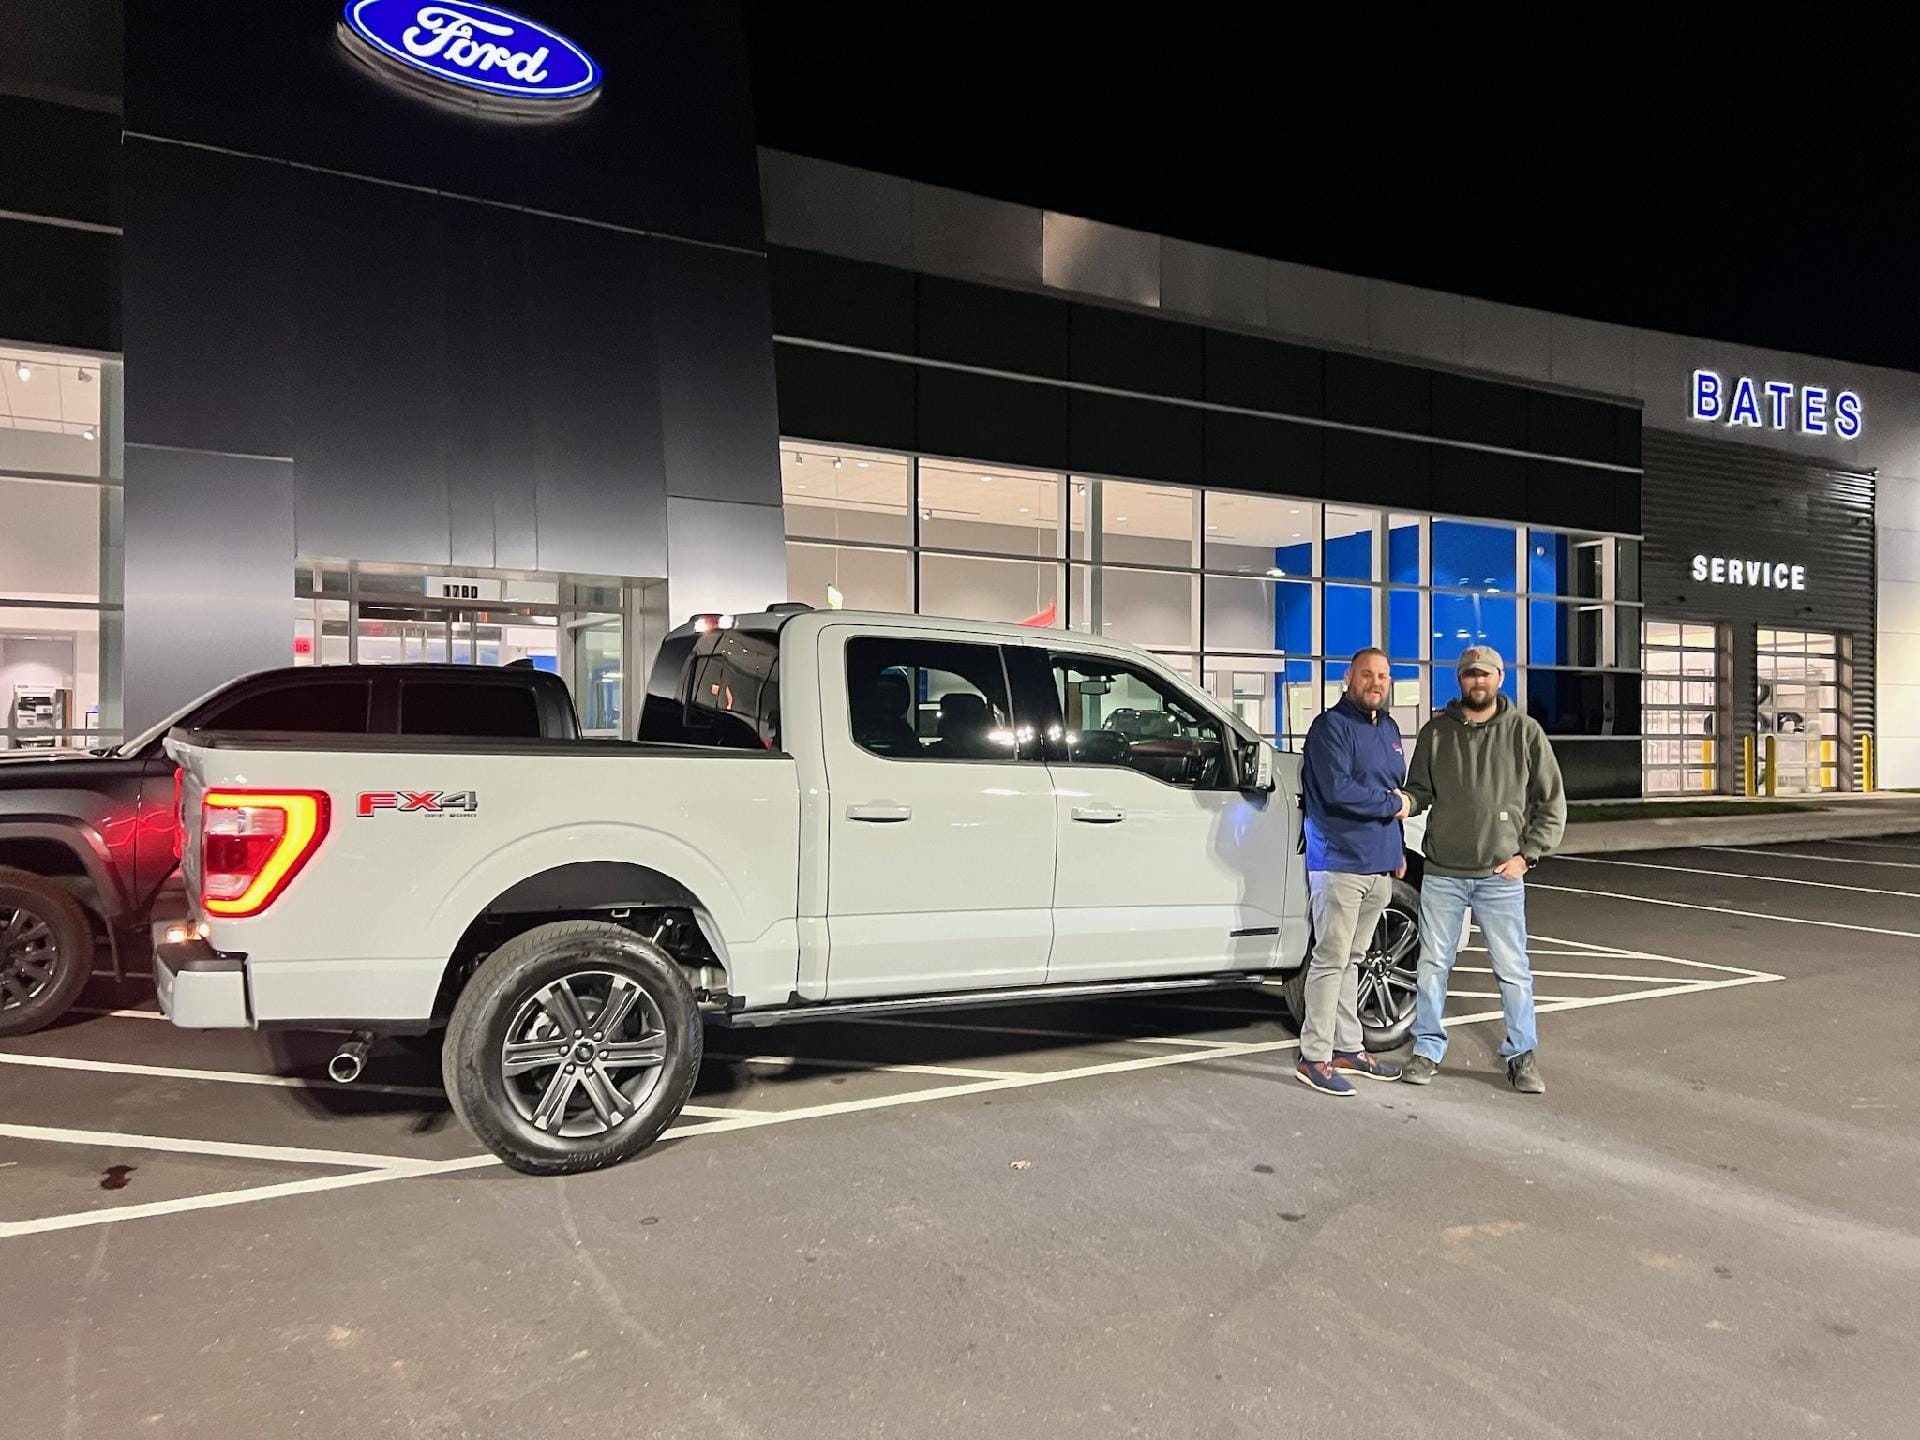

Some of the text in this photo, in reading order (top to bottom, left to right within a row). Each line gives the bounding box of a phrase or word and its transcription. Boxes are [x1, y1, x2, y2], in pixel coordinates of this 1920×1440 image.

[402, 6, 549, 83] Ford
[1693, 369, 1862, 440] BATES
[1692, 554, 1805, 590] SERVICE
[356, 791, 478, 817] FX4
